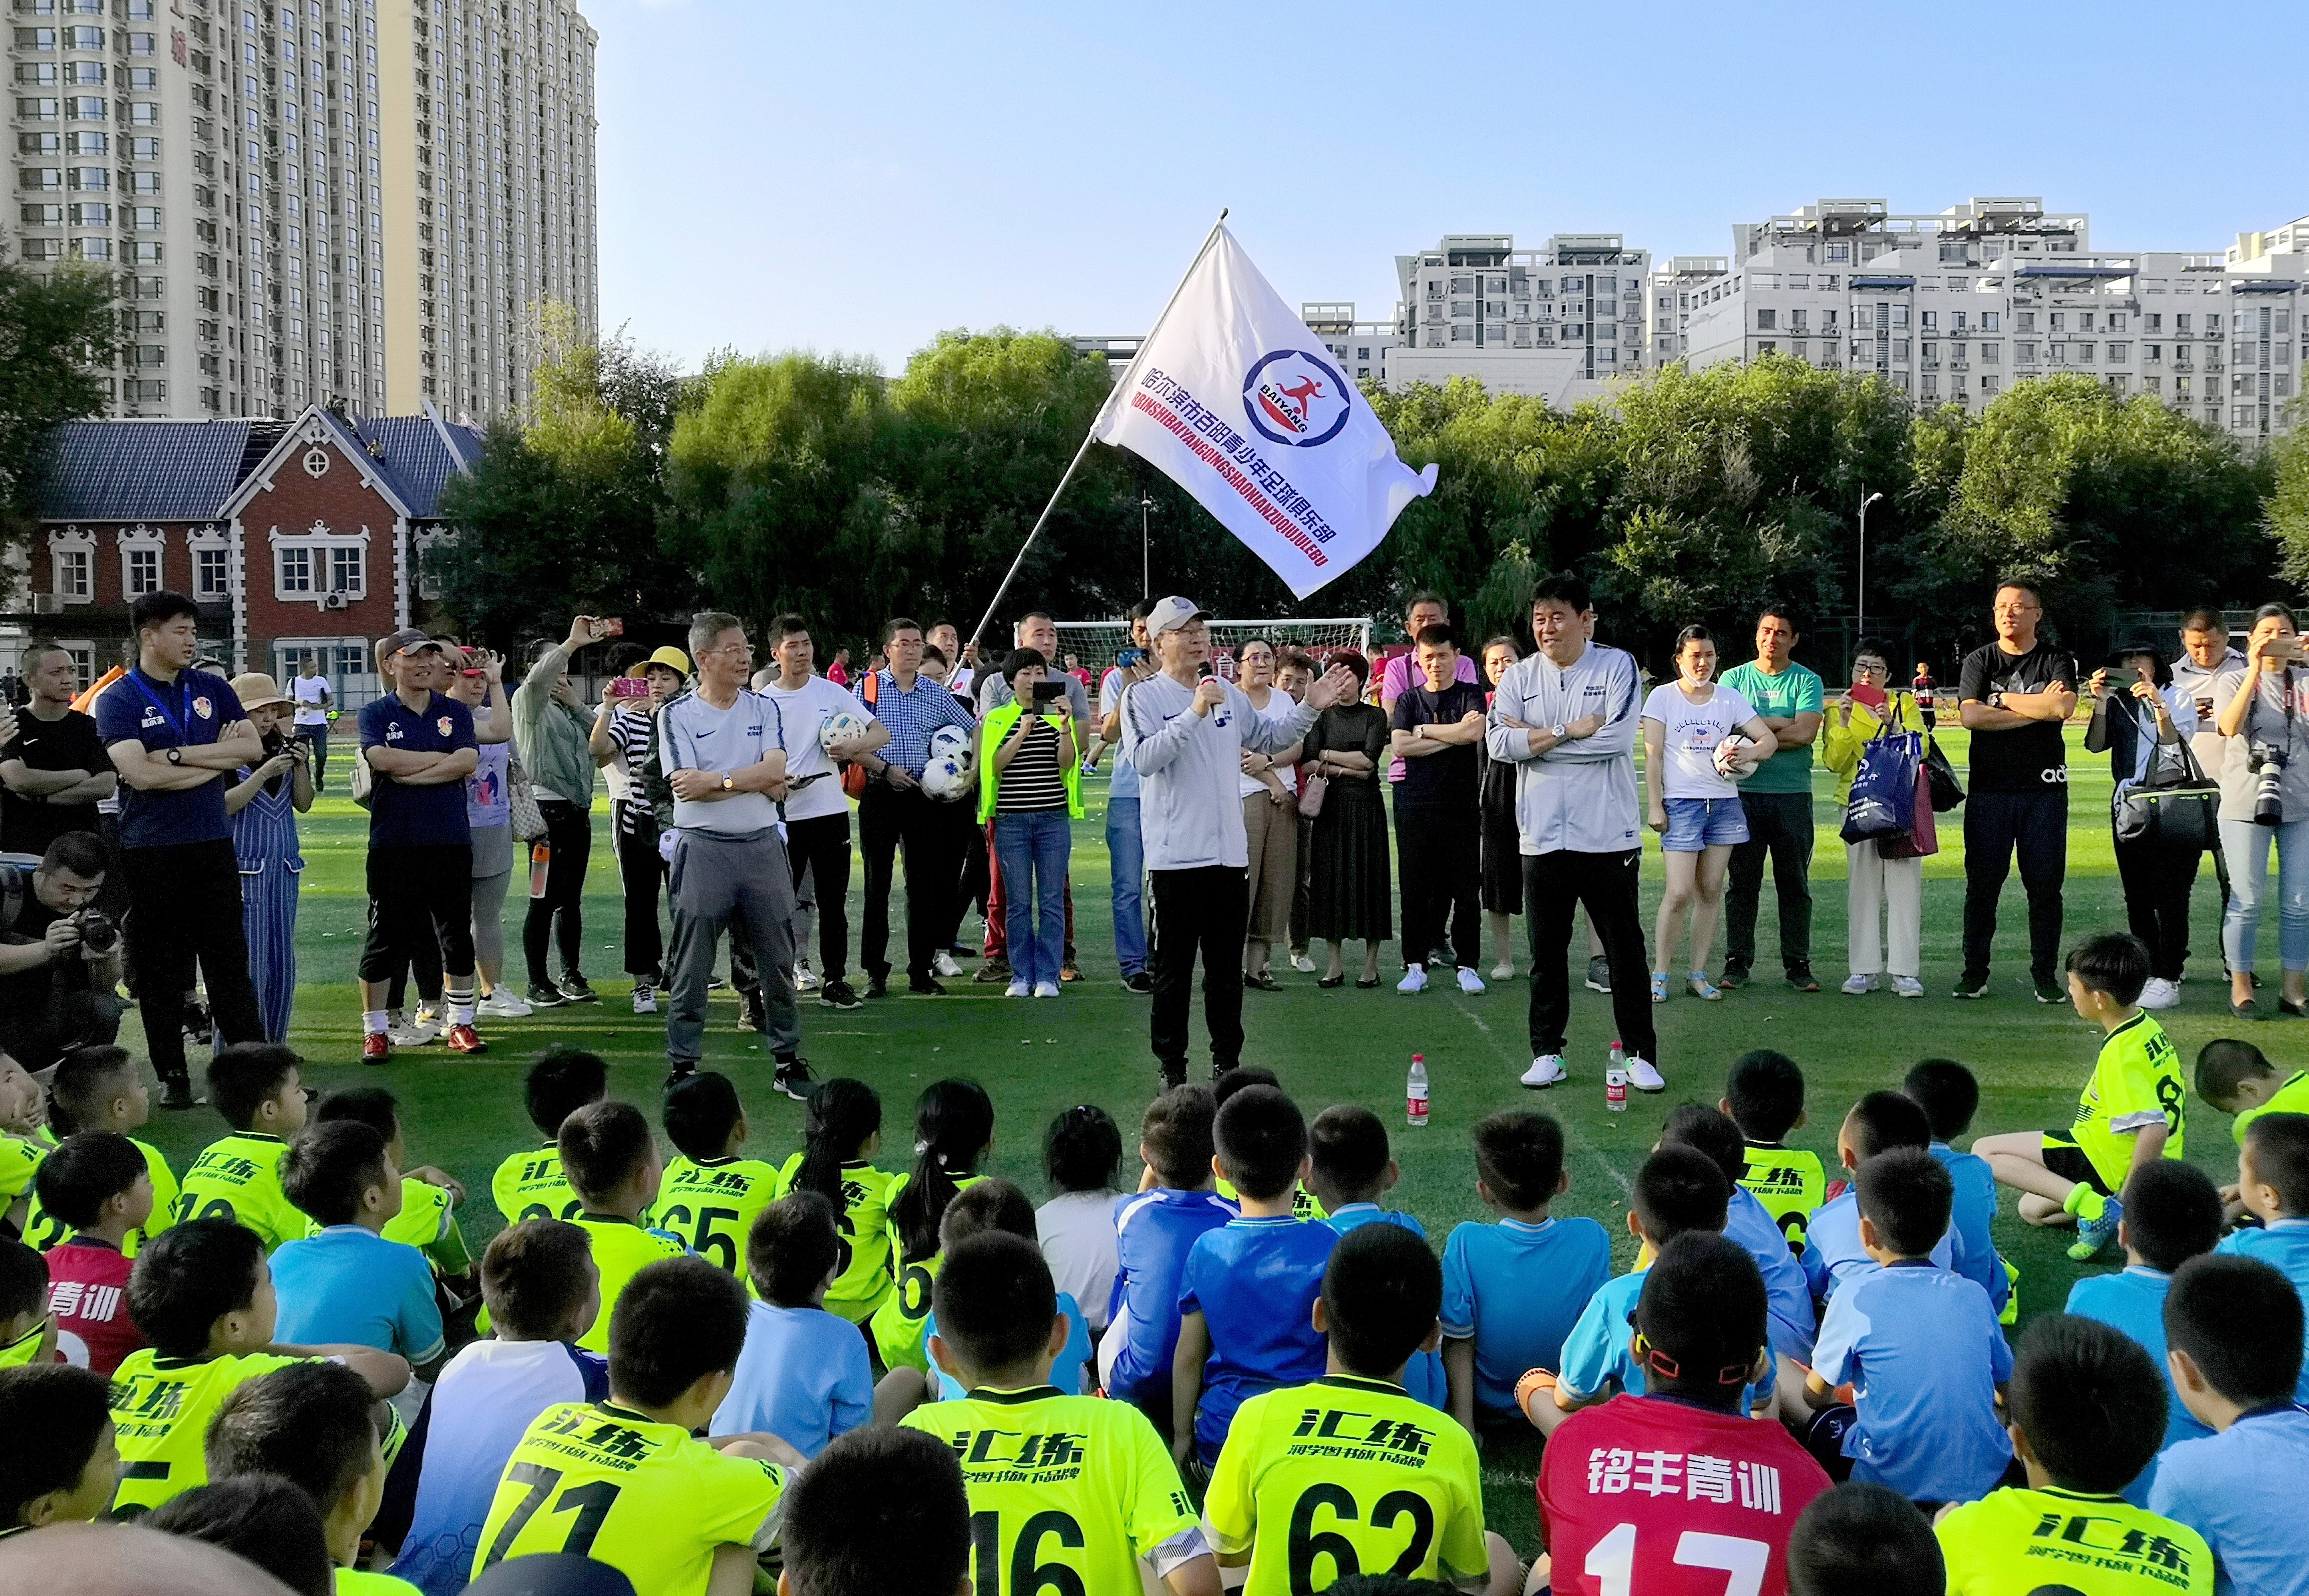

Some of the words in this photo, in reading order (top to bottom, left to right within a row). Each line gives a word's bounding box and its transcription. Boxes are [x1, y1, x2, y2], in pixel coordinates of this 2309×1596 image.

[1260, 384, 1307, 433] BAIYANG
[1141, 368, 1336, 544] 哈尔滨市百阳青少年足球俱乐部
[193, 1152, 264, 1179] 汇练
[521, 1158, 565, 1181] 汇
[673, 1168, 755, 1191] 汇练
[660, 1204, 739, 1275] 65
[539, 1408, 662, 1461] 汇练
[953, 1430, 1088, 1468] 汇练
[1292, 1409, 1437, 1457] 汇练
[484, 1461, 622, 1563] 71
[1587, 1448, 1781, 1515] 铭丰青训
[969, 1510, 1087, 1596] 16
[1288, 1482, 1434, 1596] 62
[1584, 1522, 1770, 1596] 17
[2032, 1513, 2192, 1577] 汇练
